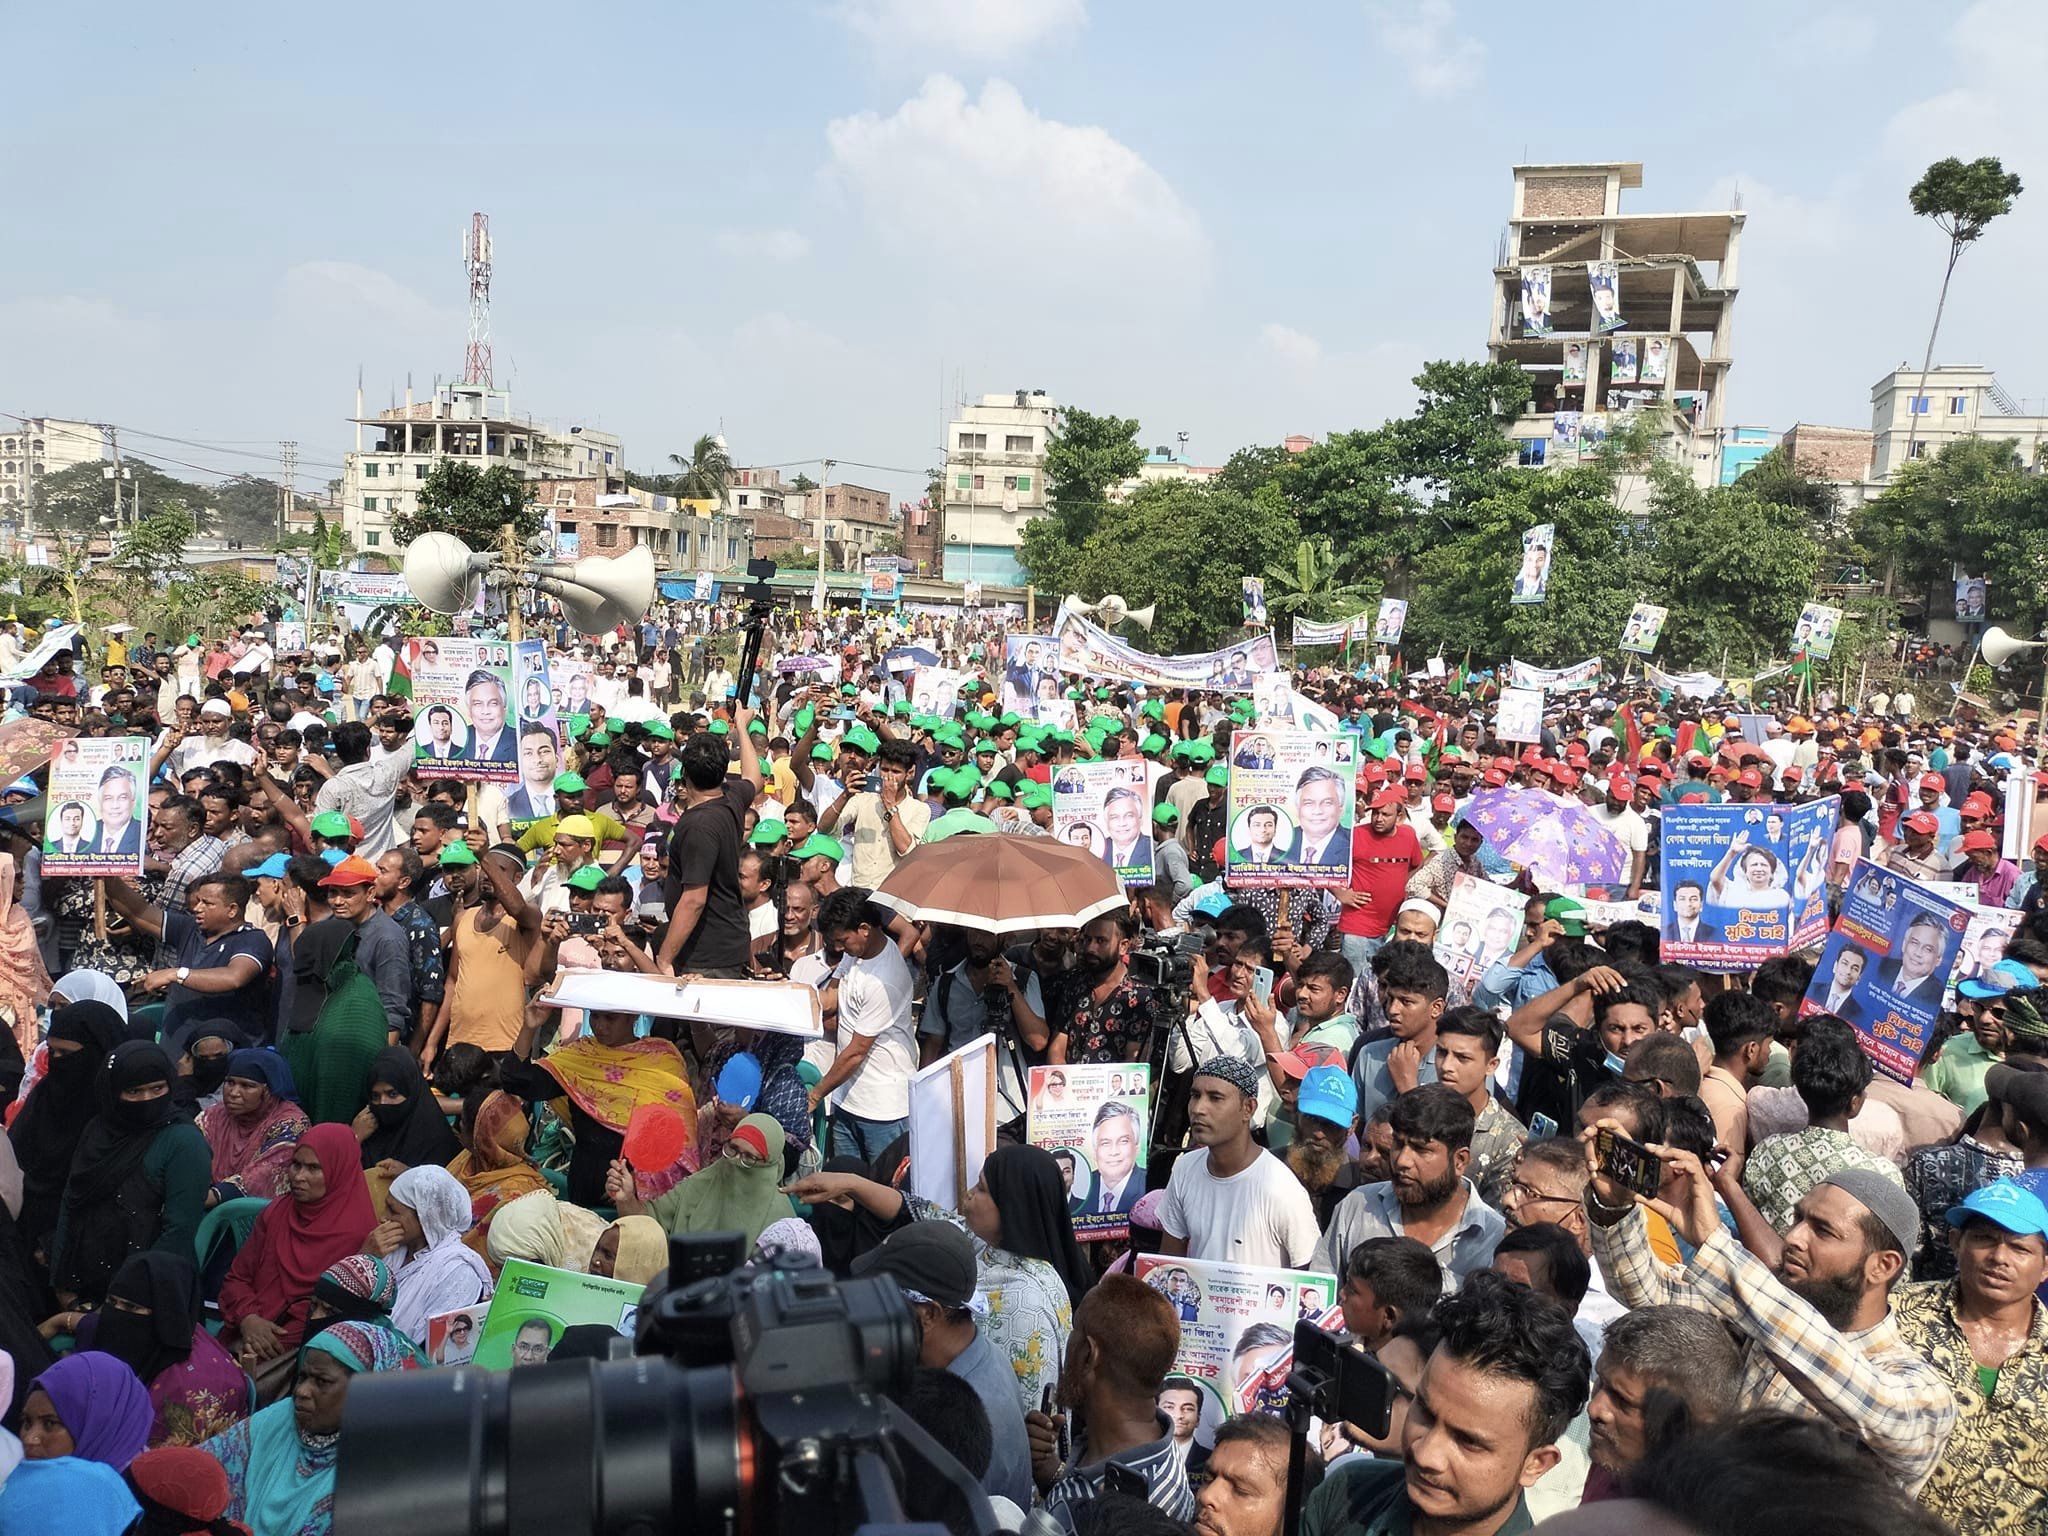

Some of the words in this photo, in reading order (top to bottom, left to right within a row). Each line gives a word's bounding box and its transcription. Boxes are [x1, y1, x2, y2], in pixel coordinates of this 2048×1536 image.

[414, 694, 438, 706] মুক্তি
[440, 694, 459, 704] চাই
[1234, 795, 1262, 808] মুক্তি
[1266, 796, 1288, 804] চাই
[1666, 834, 1685, 845] বেগম
[1687, 834, 1712, 845] খালেদা
[1713, 832, 1730, 846] জিয়া
[1840, 848, 1852, 859] SD
[1739, 908, 1779, 924] নিঃশর্ত
[1724, 923, 1755, 942] মুক্তি
[1759, 924, 1786, 940] চাই
[1888, 1011, 1923, 1036] নিঃশর্ত
[1872, 1020, 1898, 1040] মুক্তি
[1900, 1033, 1924, 1054] চাই
[1063, 1136, 1085, 1147] চাই
[1208, 1284, 1230, 1294] তারেক
[1194, 1326, 1214, 1339] জিয়া
[1190, 1351, 1217, 1360] আমান
[1184, 1363, 1221, 1379] চাই
